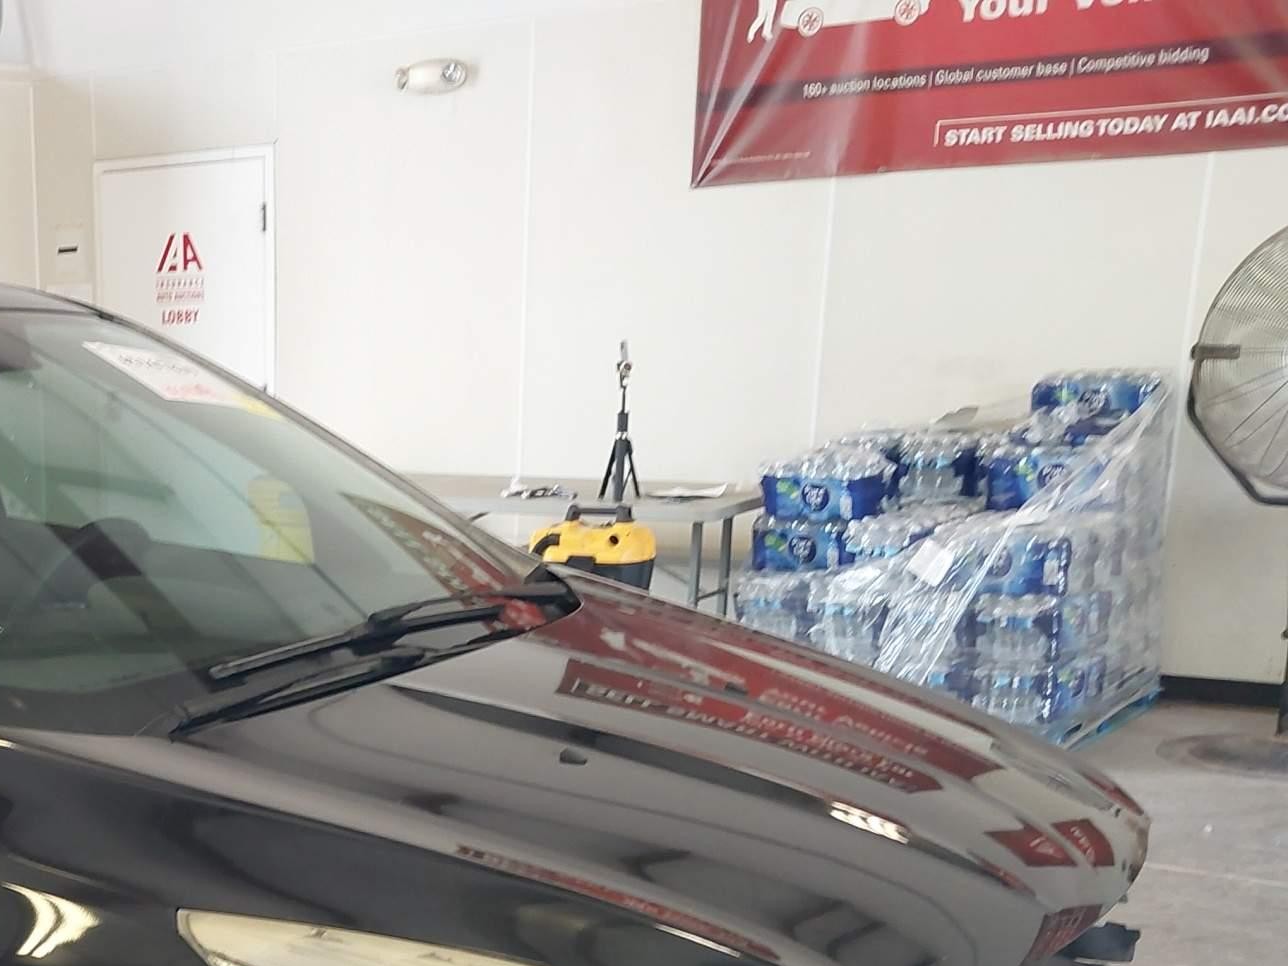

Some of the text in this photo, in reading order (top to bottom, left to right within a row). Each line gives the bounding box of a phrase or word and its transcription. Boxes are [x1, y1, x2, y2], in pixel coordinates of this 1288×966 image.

[803, 82, 827, 99] 160+
[829, 79, 870, 96] auction
[872, 74, 927, 92] locations
[935, 67, 974, 86] Global
[976, 63, 1034, 82] customer
[1036, 61, 1067, 78] base
[1077, 51, 1154, 74] Competitive
[1158, 47, 1209, 65] bidding
[944, 126, 1007, 147] START
[1010, 120, 1094, 142] SELLING
[1096, 114, 1168, 137] TODAY
[1171, 111, 1202, 132] AT
[162, 308, 199, 325] LOBBY
